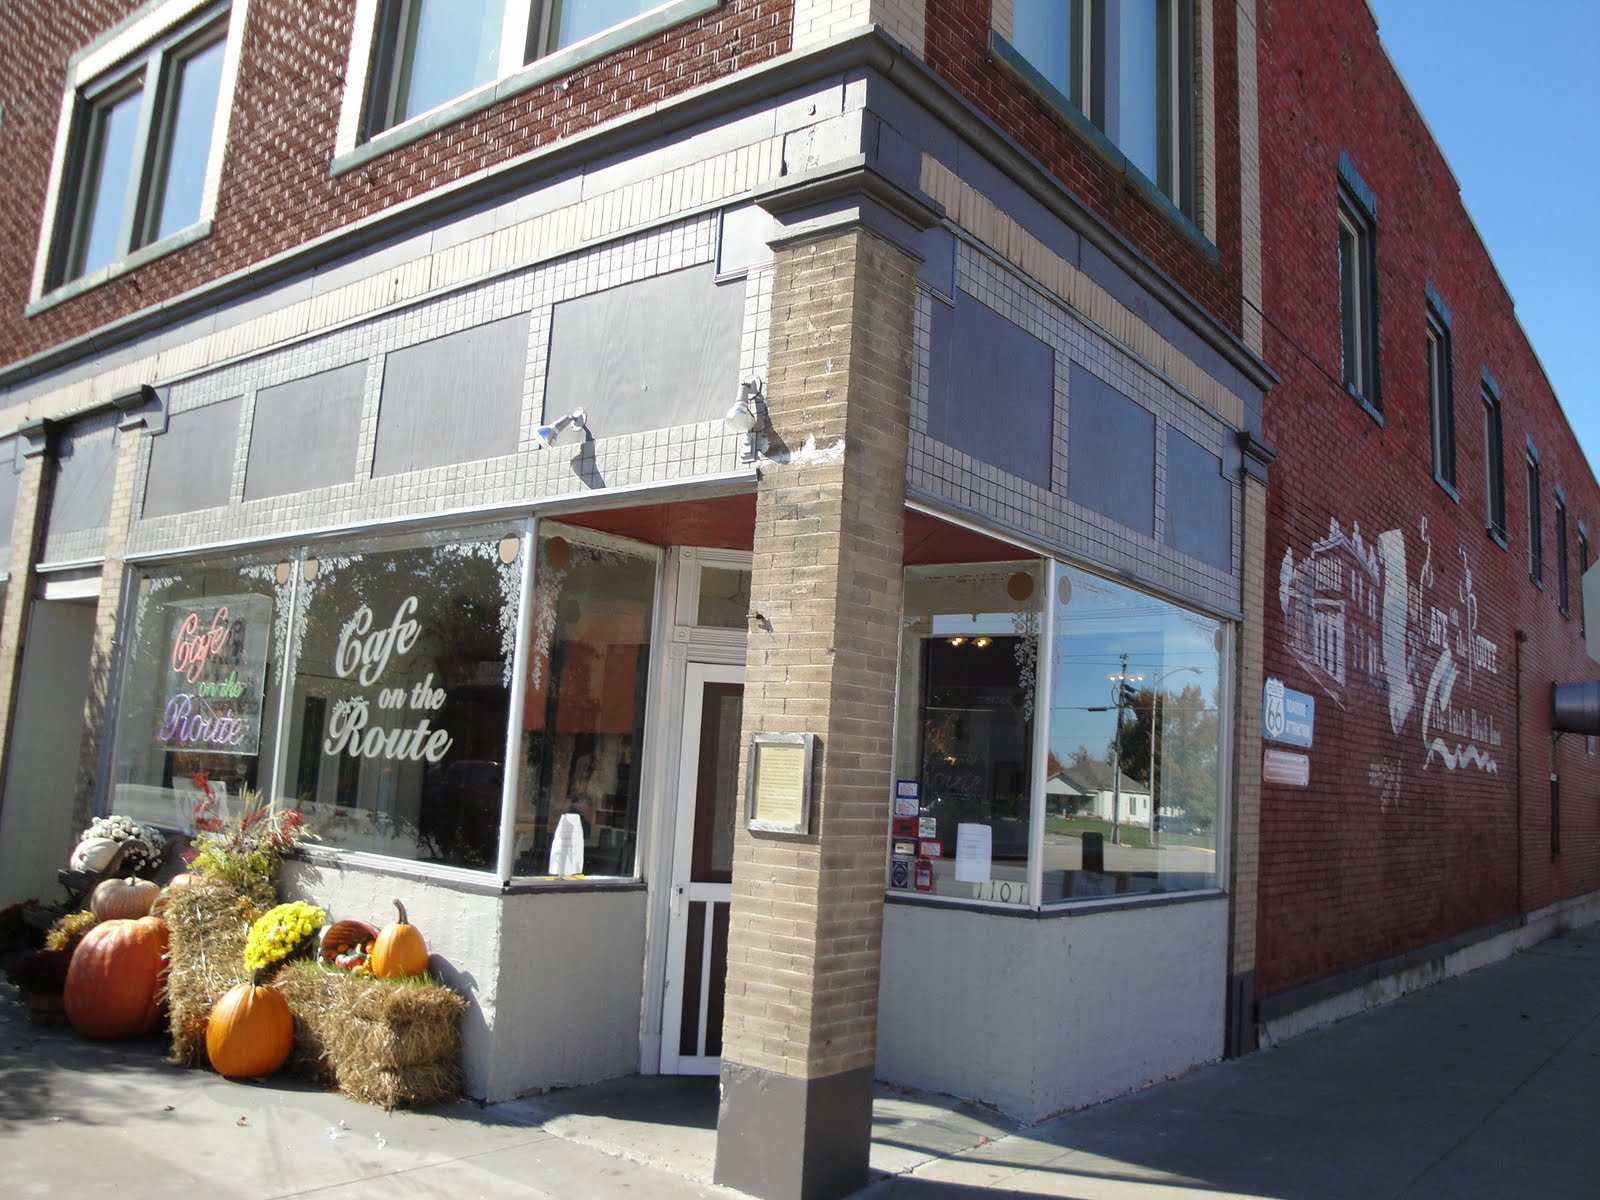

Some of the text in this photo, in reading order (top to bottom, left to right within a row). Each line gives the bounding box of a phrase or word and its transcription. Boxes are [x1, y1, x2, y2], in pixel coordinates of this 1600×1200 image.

[173, 607, 229, 683] Cafe
[335, 596, 422, 687] Cafe
[199, 671, 247, 698] on the
[378, 672, 447, 710] on the
[160, 693, 247, 745] Route
[324, 696, 454, 763] Route
[1267, 697, 1283, 733] 66
[977, 880, 1025, 904] 1101
